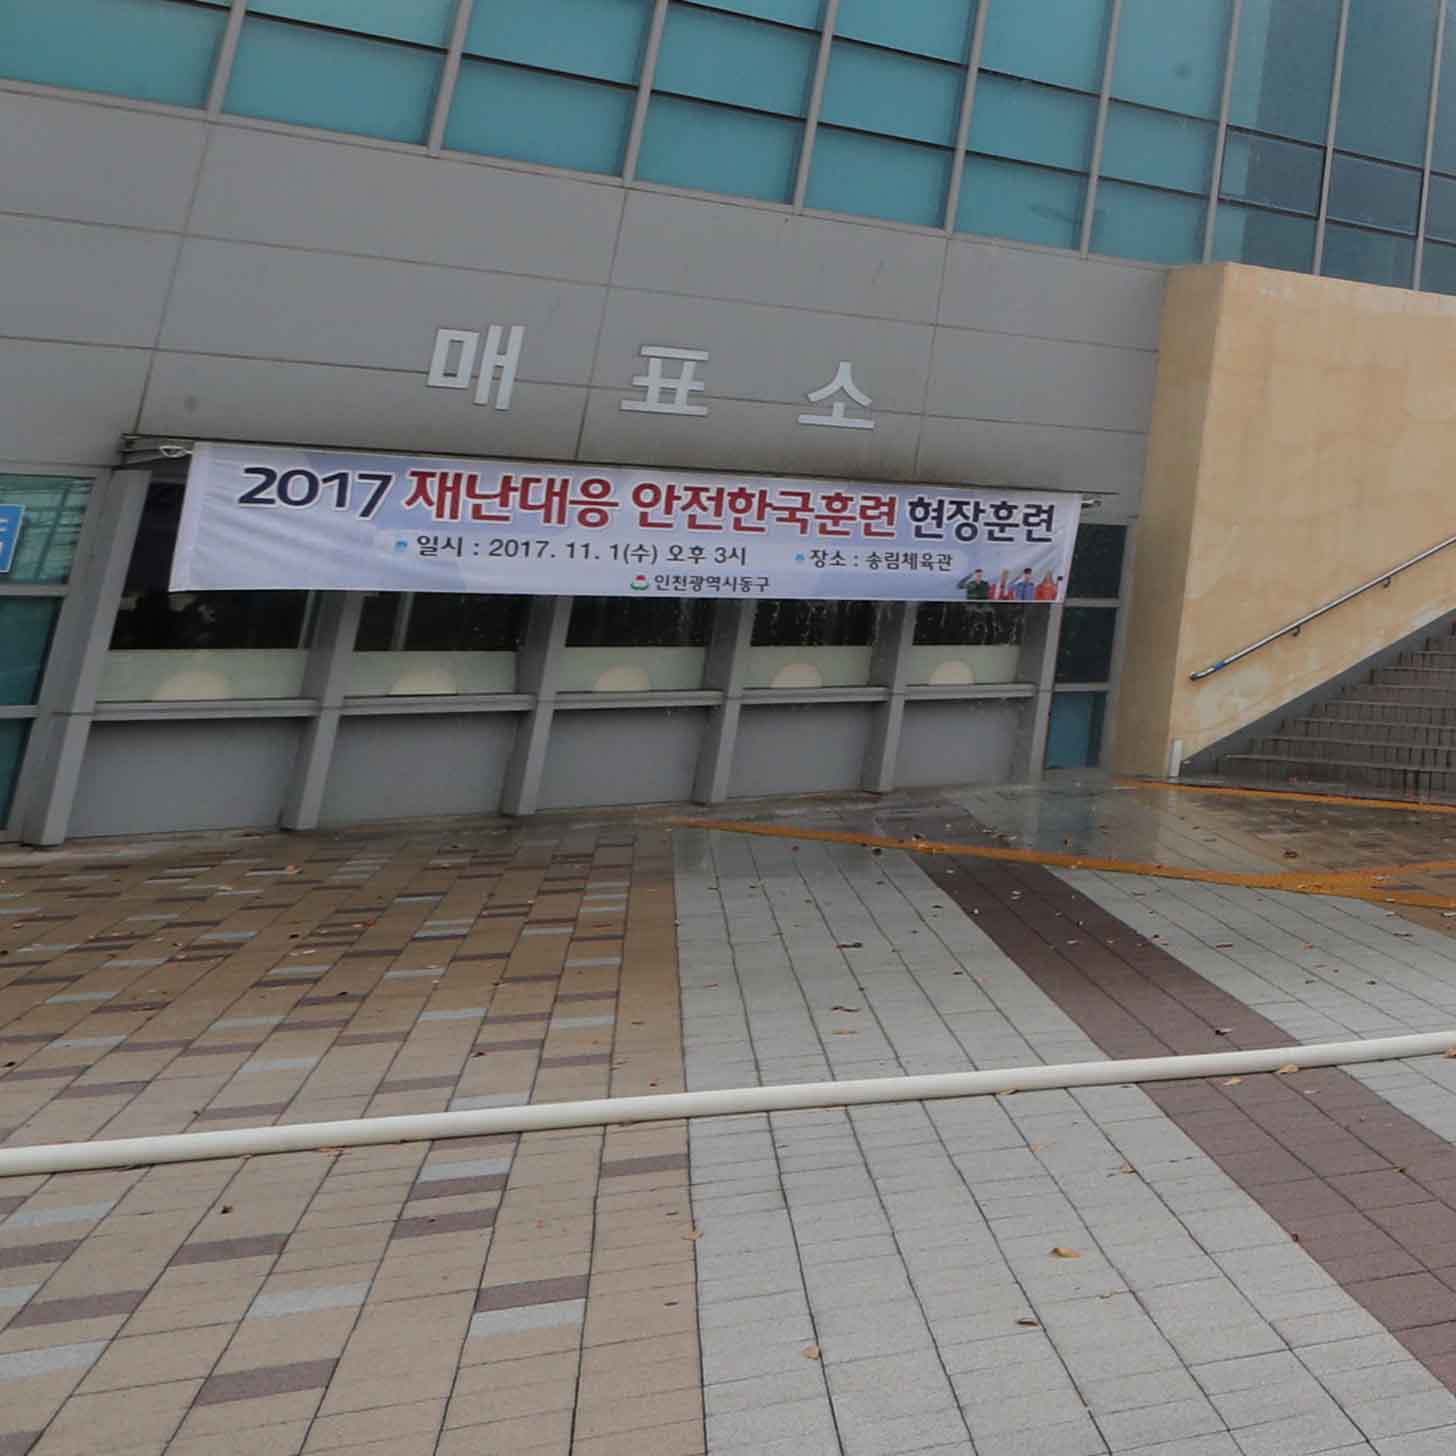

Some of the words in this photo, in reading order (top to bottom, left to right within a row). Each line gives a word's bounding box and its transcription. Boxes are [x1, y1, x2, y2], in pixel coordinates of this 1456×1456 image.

[237, 465, 394, 519] 2017
[404, 470, 619, 529] 재난대응
[631, 482, 897, 539] 안전한국훈련
[907, 495, 1056, 543] 현장훈련
[416, 535, 464, 558] 일시
[489, 538, 556, 559] 2017.
[566, 543, 600, 560] 11.
[666, 545, 705, 564] 오후
[714, 546, 748, 566] 3시
[809, 549, 846, 568] 장소
[864, 552, 952, 572] 송림체육관
